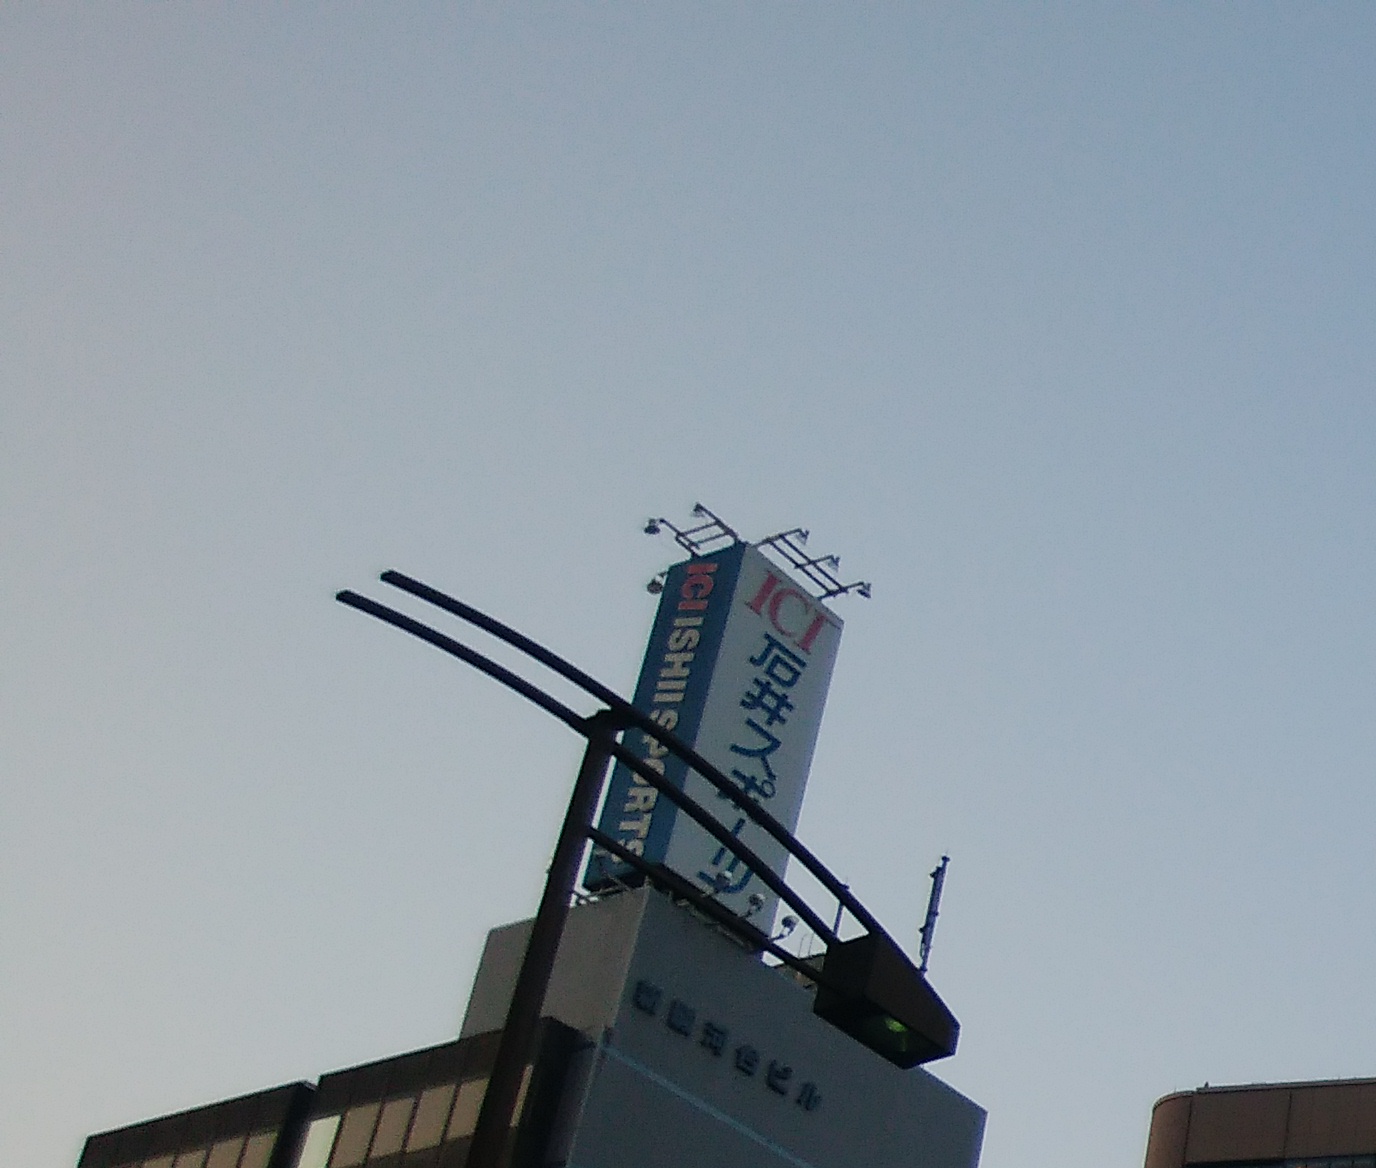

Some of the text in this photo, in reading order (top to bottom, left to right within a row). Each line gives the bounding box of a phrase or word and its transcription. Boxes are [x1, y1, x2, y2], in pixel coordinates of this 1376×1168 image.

[677, 563, 718, 611] ICI
[744, 570, 842, 655] ICI
[653, 617, 704, 703] ISHII
